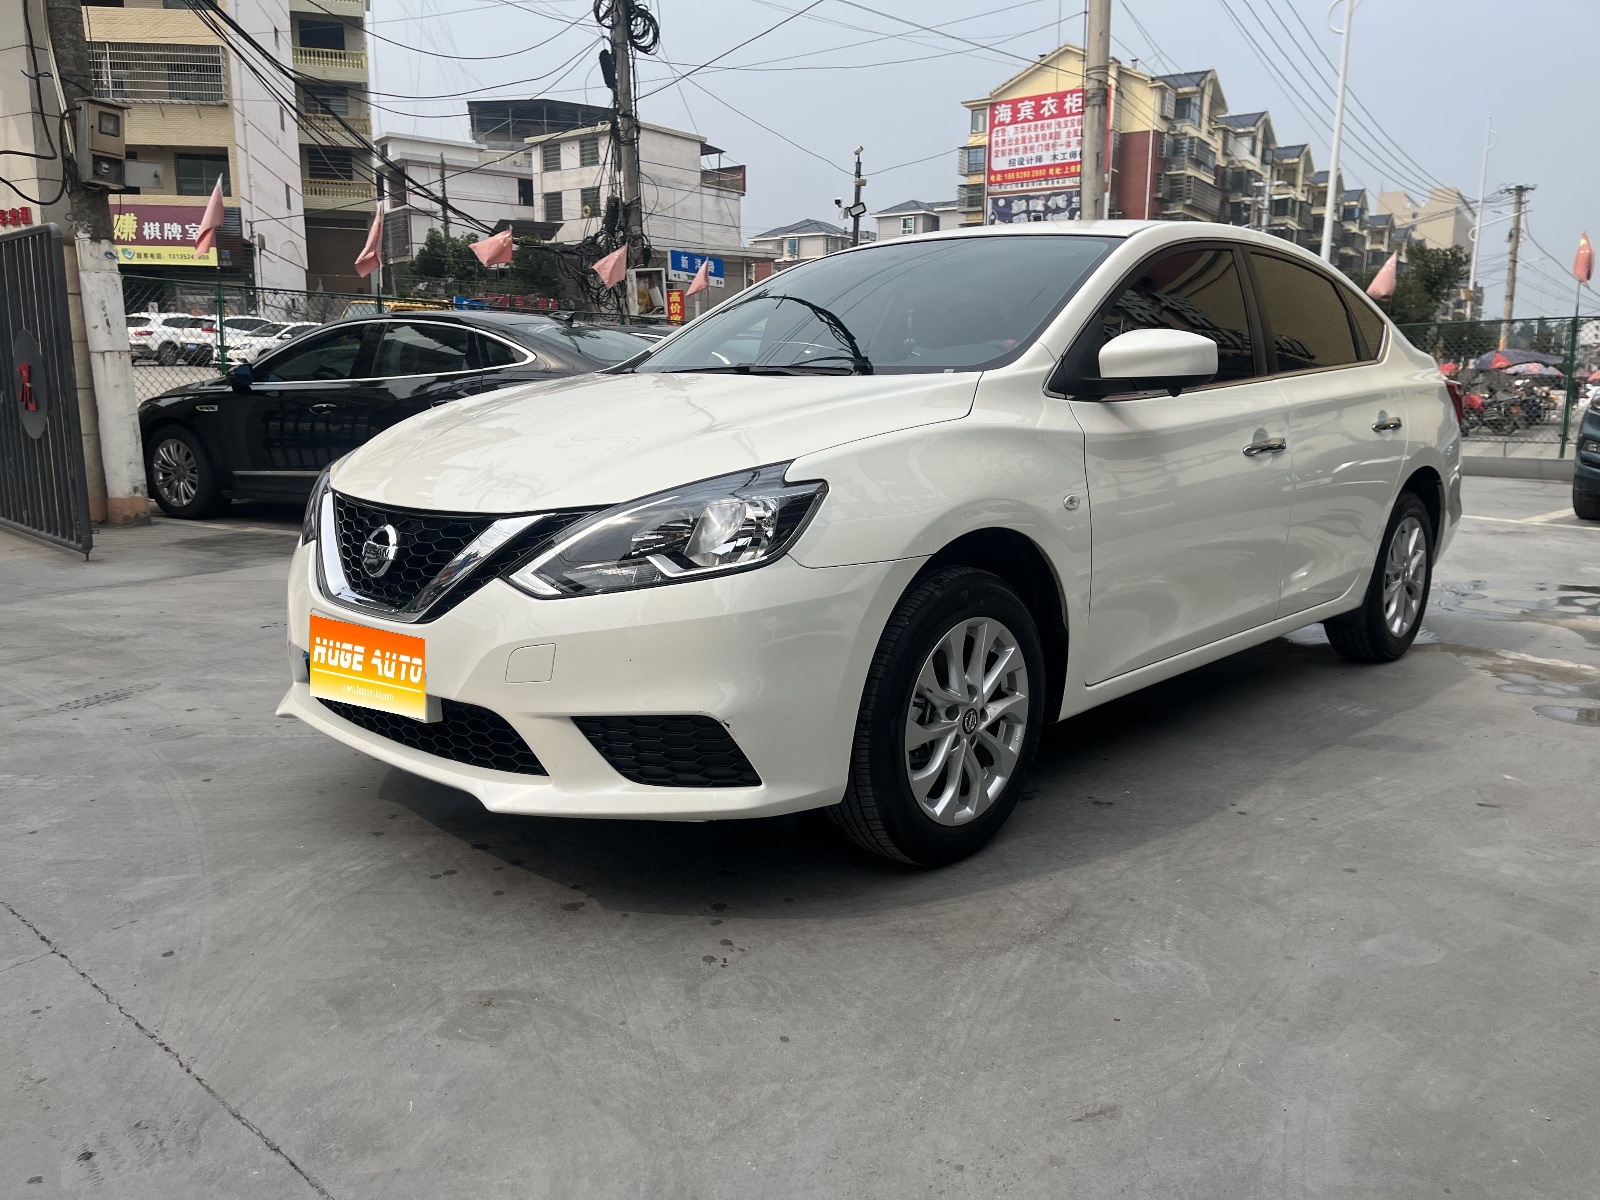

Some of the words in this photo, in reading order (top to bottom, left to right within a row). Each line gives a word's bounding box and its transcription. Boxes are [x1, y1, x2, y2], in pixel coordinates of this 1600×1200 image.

[994, 92, 1083, 124] 海宾衣柜
[142, 221, 202, 241] 棋牌室
